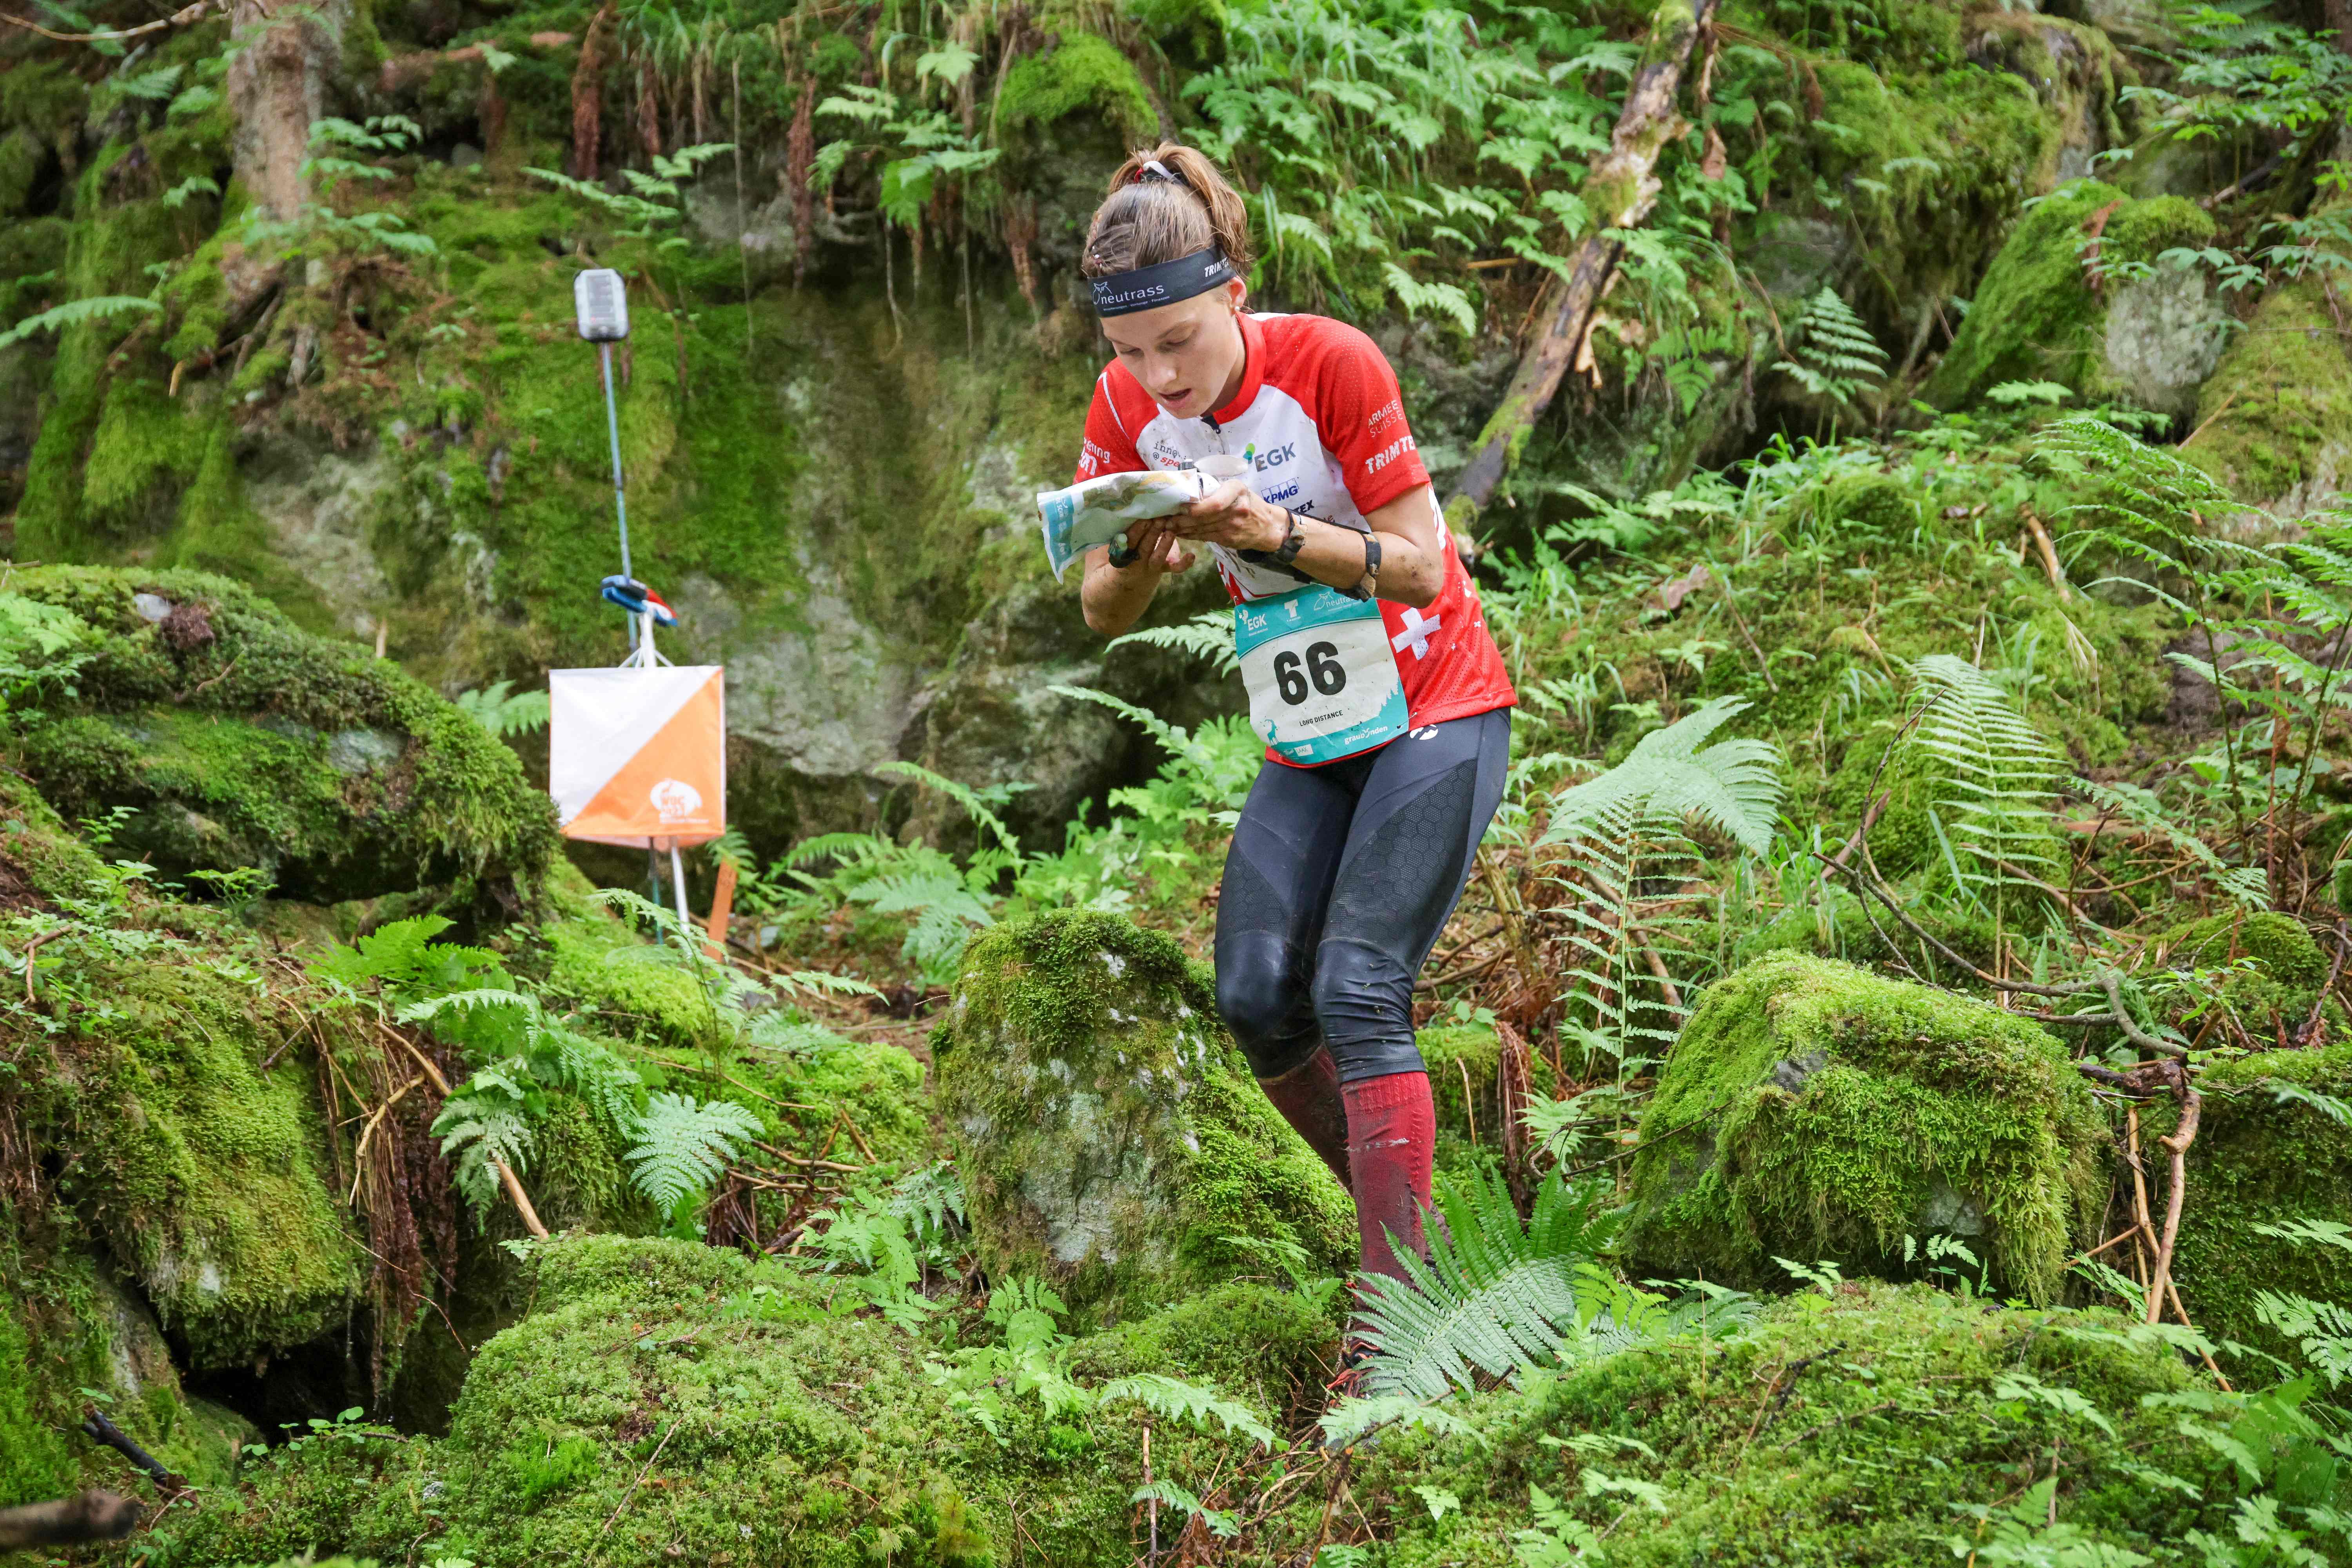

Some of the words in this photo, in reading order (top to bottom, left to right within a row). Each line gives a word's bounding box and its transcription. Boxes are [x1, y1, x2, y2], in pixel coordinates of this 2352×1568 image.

[1101, 285, 1164, 305] neutrass
[1368, 399, 1399, 428] ARMEE
[1370, 410, 1403, 438] SUISSE
[1254, 442, 1296, 472] EGK
[1263, 485, 1298, 503] KPMG
[1326, 596, 1356, 608] neutra
[1248, 613, 1267, 631] EGK
[1274, 641, 1346, 705] 66
[1299, 718, 1314, 727] LONG
[1314, 710, 1343, 723] DISTANCE
